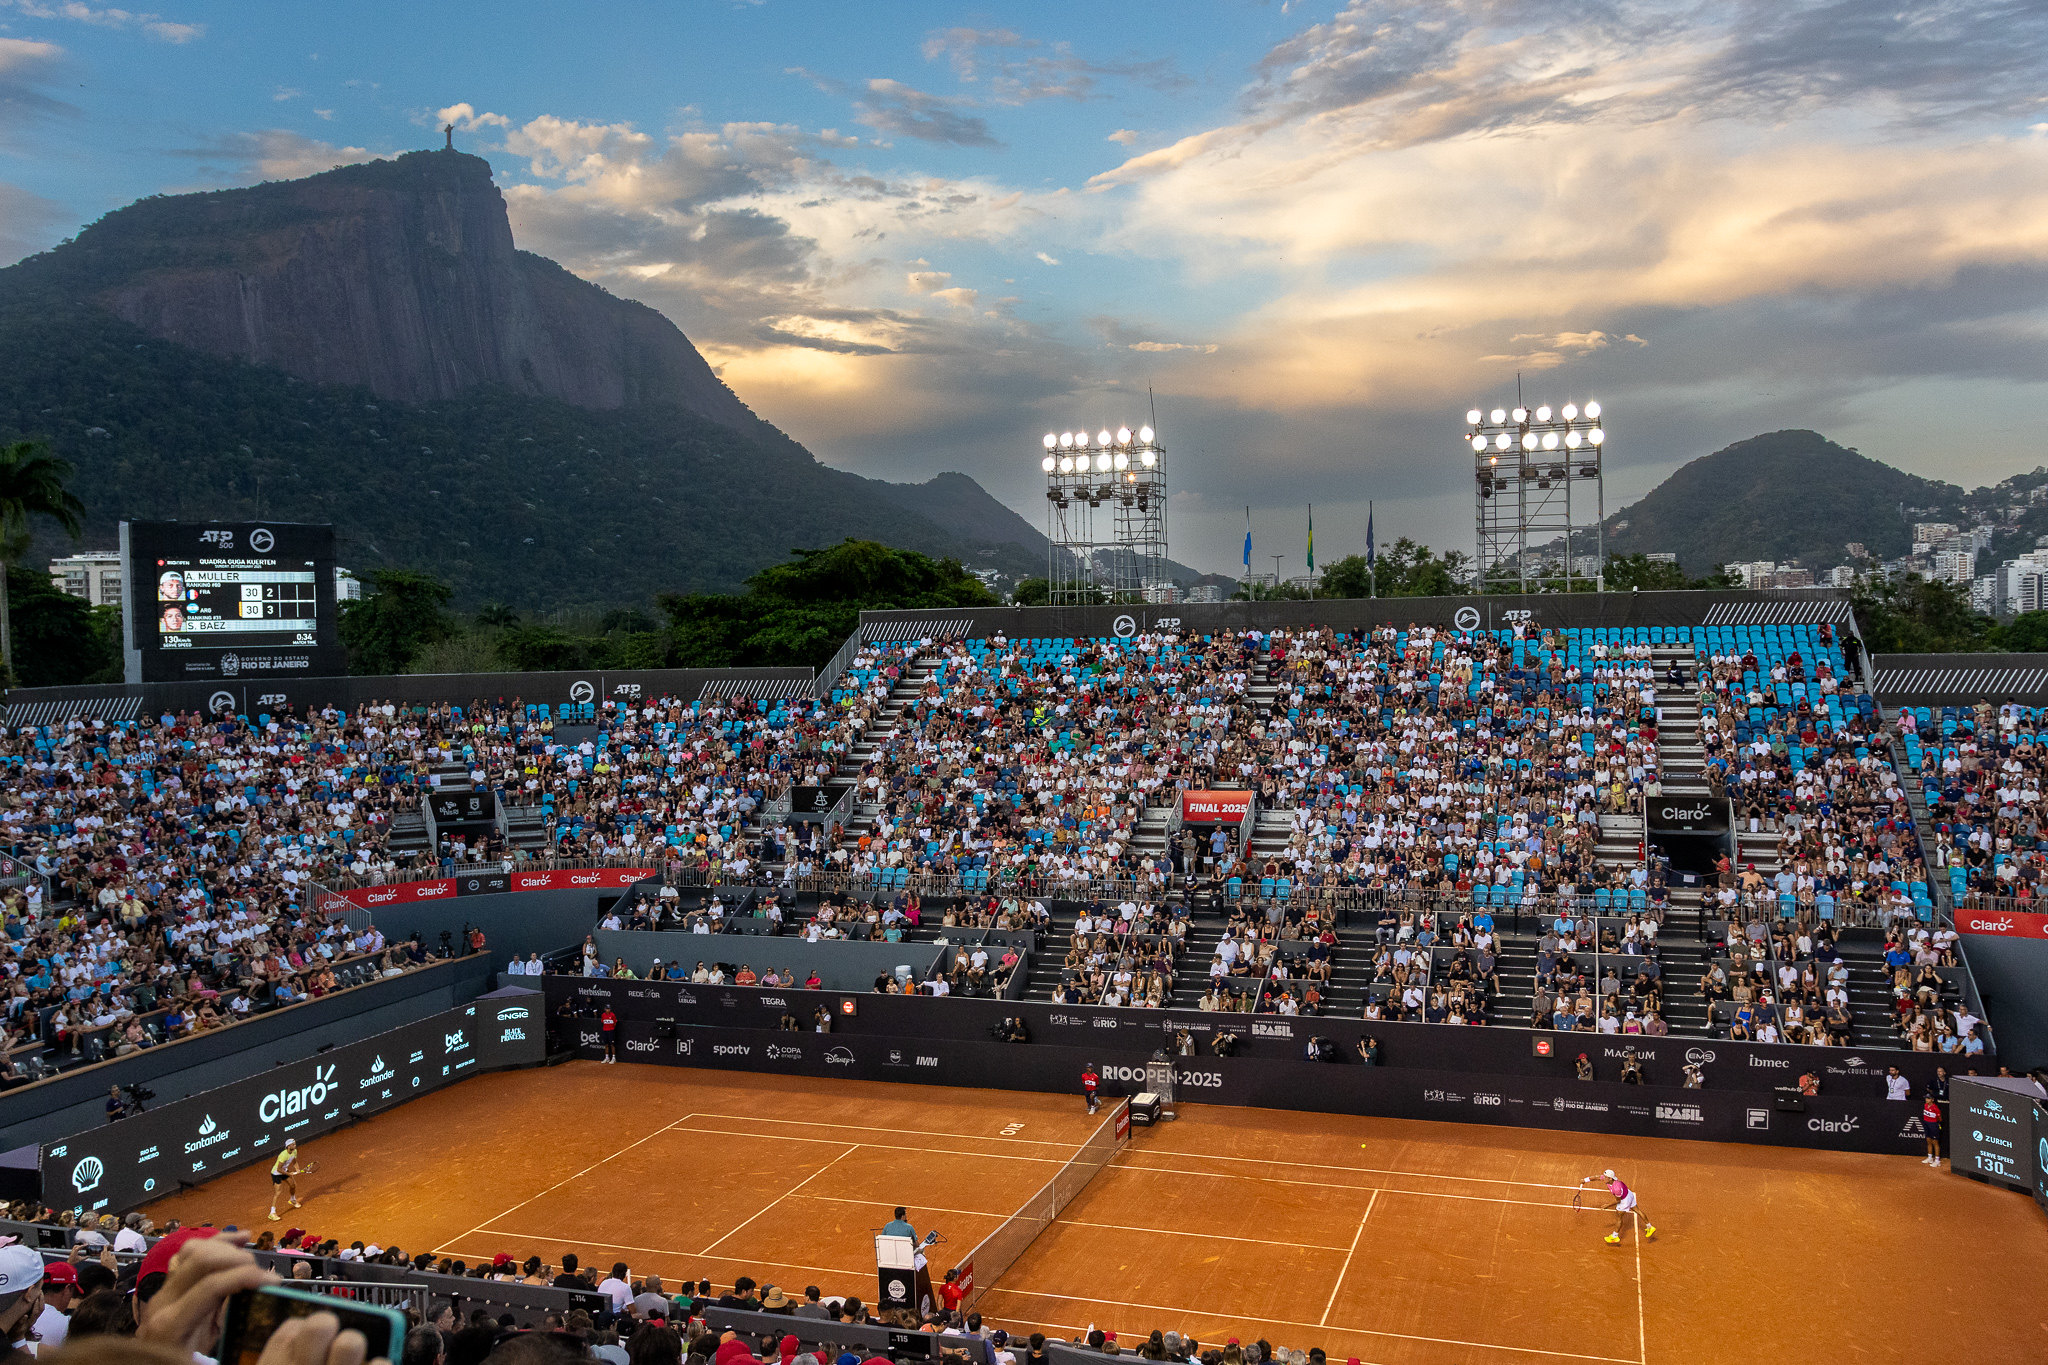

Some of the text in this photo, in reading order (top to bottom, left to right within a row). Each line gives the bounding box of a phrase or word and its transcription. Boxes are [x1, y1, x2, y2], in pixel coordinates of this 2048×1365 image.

[199, 530, 234, 543] ATP
[186, 572, 240, 581] A. MULLER
[246, 588, 273, 597] 30 2
[246, 606, 274, 614] 30 3
[1502, 610, 1532, 620] ATP
[1154, 618, 1180, 628] ATP
[272, 660, 310, 668] JANEIRO
[614, 684, 640, 694] ATP
[257, 694, 286, 704] ATP
[1189, 804, 1248, 813] FINAL 2025
[1662, 805, 1709, 820] Claro
[521, 876, 550, 887] Claro
[571, 874, 600, 884] Claro
[417, 885, 446, 896] Claro
[368, 891, 395, 902] Claro
[324, 898, 346, 910] Claro
[1970, 918, 2011, 931] Claro
[760, 997, 786, 1006] TEGRA
[1100, 1020, 1117, 1028] RIO
[1252, 1024, 1294, 1038] BRASIL
[445, 1029, 464, 1048] bet
[580, 1031, 600, 1044] bet
[626, 1038, 658, 1052] Claro
[713, 1044, 750, 1056] sportv
[1604, 1048, 1656, 1060] MAGUM
[916, 1056, 938, 1066] IMM
[1749, 1054, 1790, 1068] ibmec
[1848, 1067, 1868, 1076] CRUISE
[360, 1069, 395, 1089] Santander
[260, 1072, 334, 1123] Claro
[1482, 1096, 1501, 1106] RIO
[324, 1109, 338, 1120] Claro
[1656, 1106, 1704, 1122] BRASIL
[1970, 1106, 2018, 1124] MUBADALA
[1000, 1122, 1026, 1136] RIO
[1808, 1116, 1857, 1132] Claro
[184, 1129, 230, 1154] Santander
[254, 1136, 270, 1147] Claro
[1985, 1135, 2012, 1148] ZURICH
[1980, 1150, 2014, 1165] SERVE SPEED
[1975, 1156, 2004, 1175] 130
[575, 1294, 586, 1302] 114
[896, 1334, 908, 1342] 115
